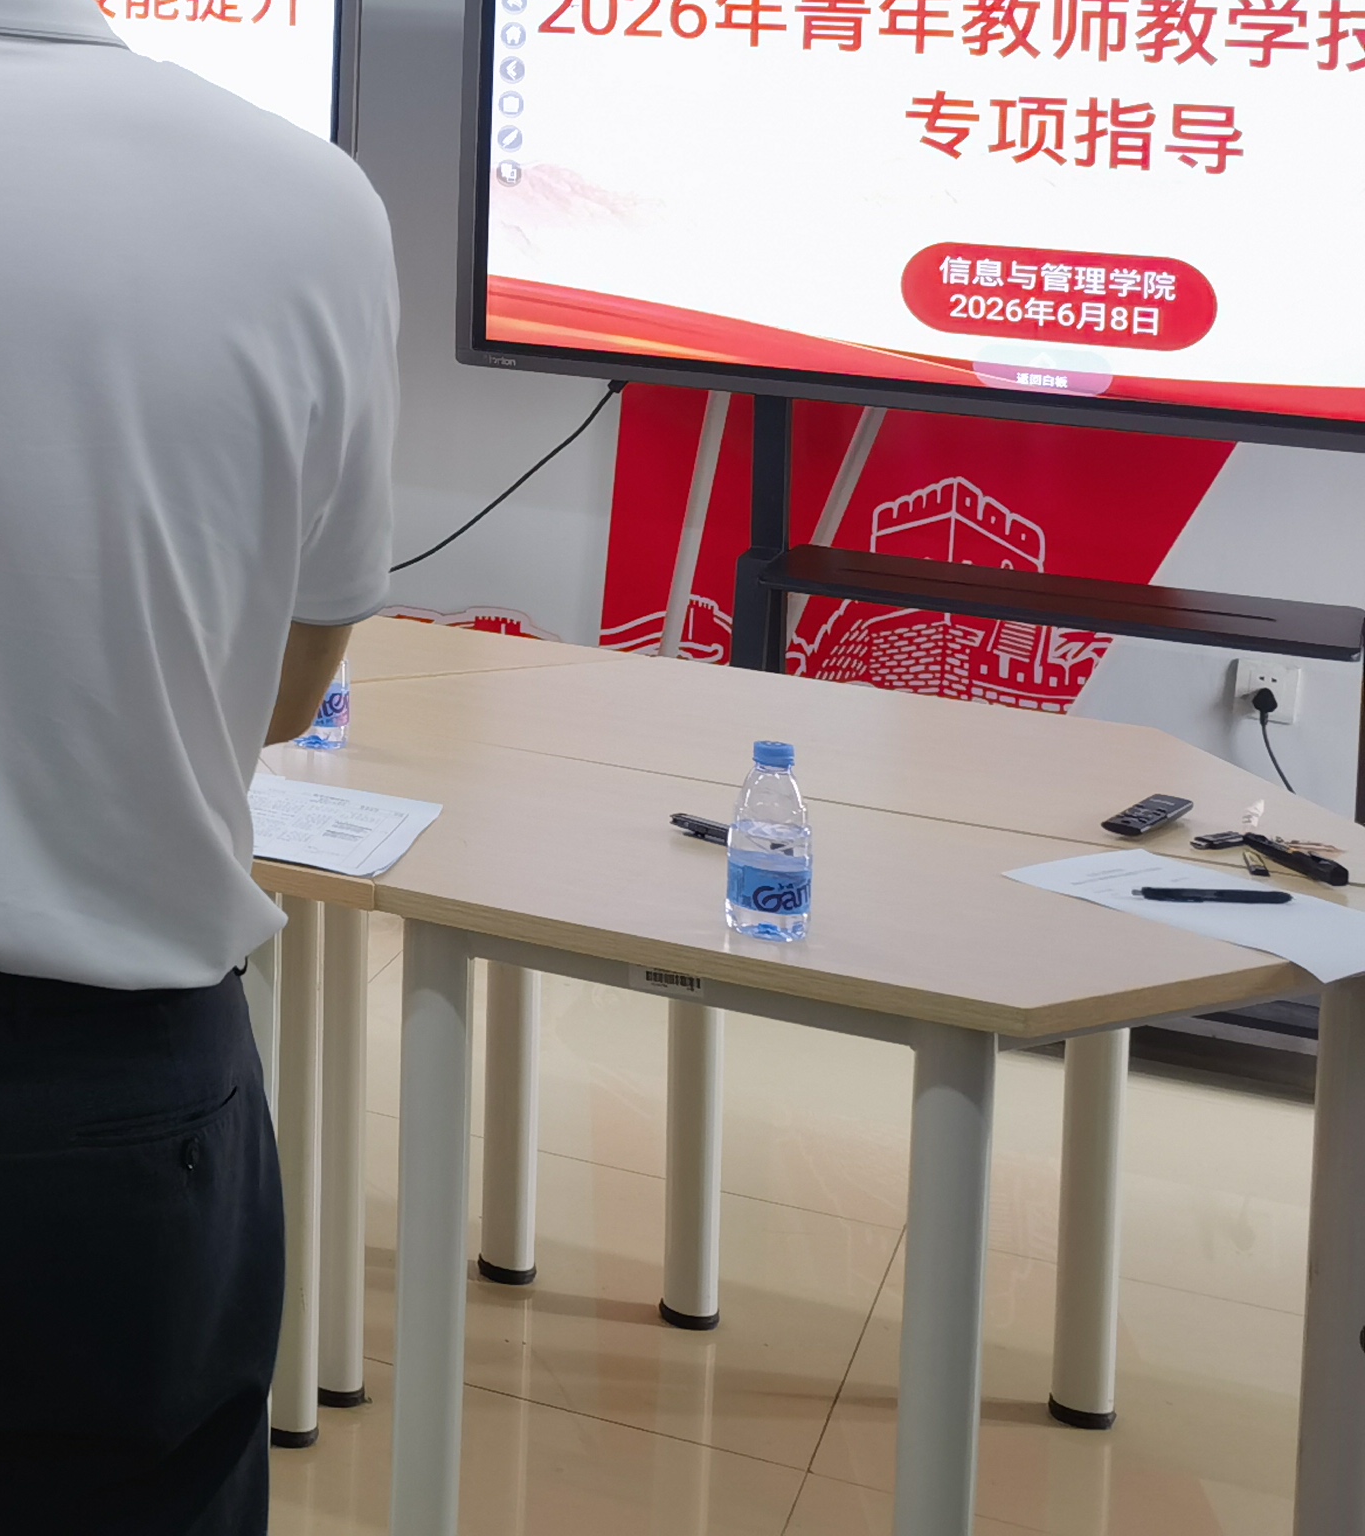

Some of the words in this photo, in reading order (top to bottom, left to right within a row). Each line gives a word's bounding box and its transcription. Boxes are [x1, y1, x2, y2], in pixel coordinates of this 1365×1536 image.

[904, 89, 1245, 176] 专项指导
[938, 255, 1177, 302] 信息与管理学院
[948, 293, 1160, 337] 2026年6月8日
[1015, 372, 1068, 389] 返回白板
